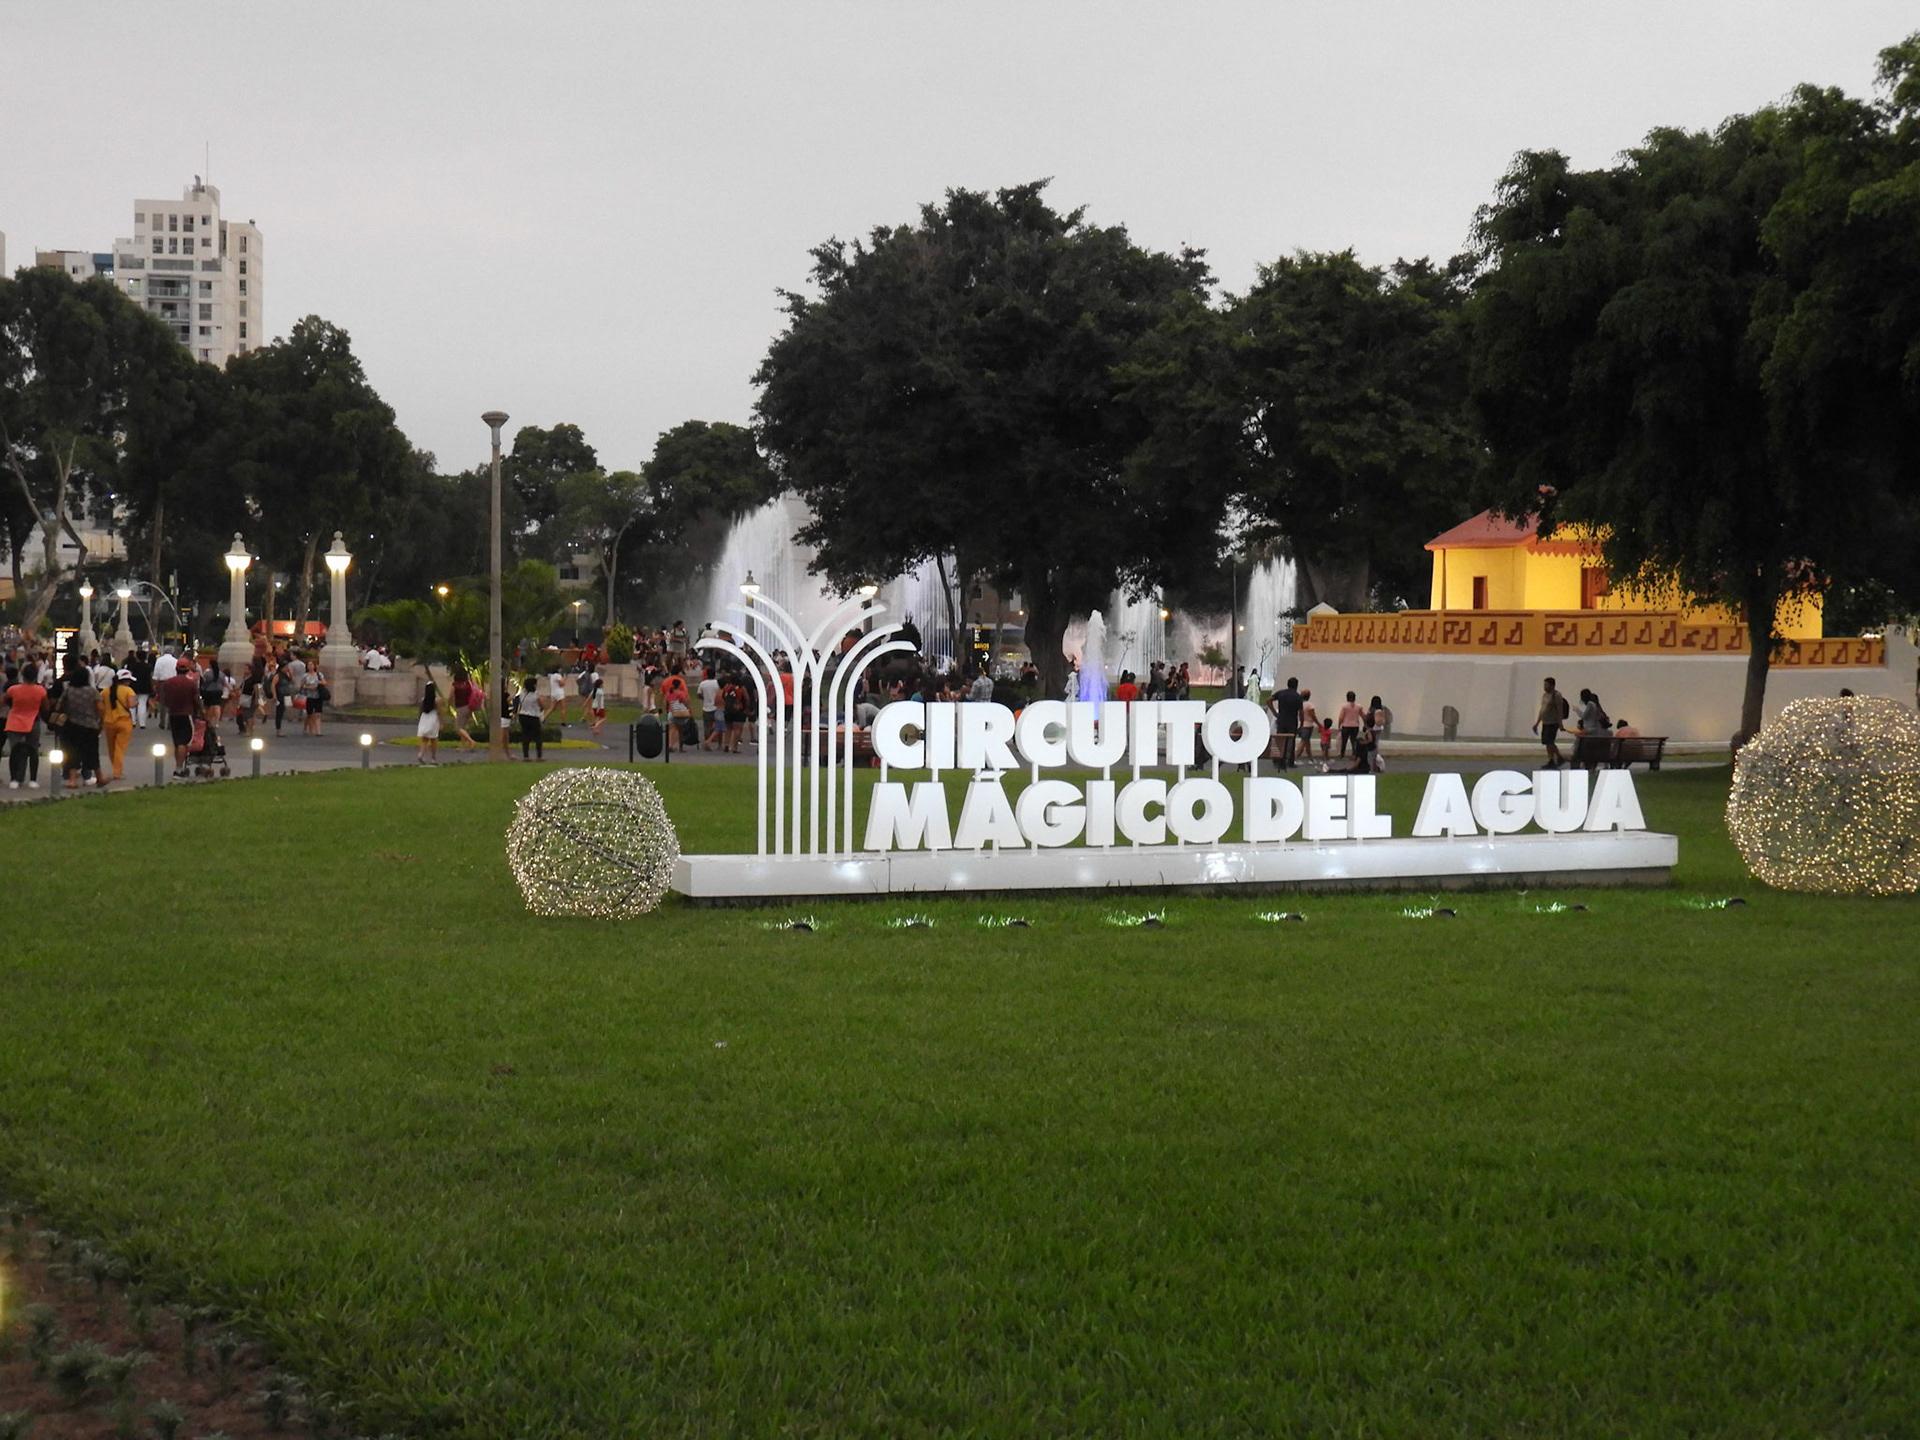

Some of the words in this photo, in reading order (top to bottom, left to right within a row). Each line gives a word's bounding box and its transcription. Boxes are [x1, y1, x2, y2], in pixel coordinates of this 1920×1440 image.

[871, 698, 1271, 769] CIRCUITO
[864, 770, 1234, 851] MÁGICO
[1243, 774, 1392, 842] DEL
[1412, 768, 1646, 838] AGUA
